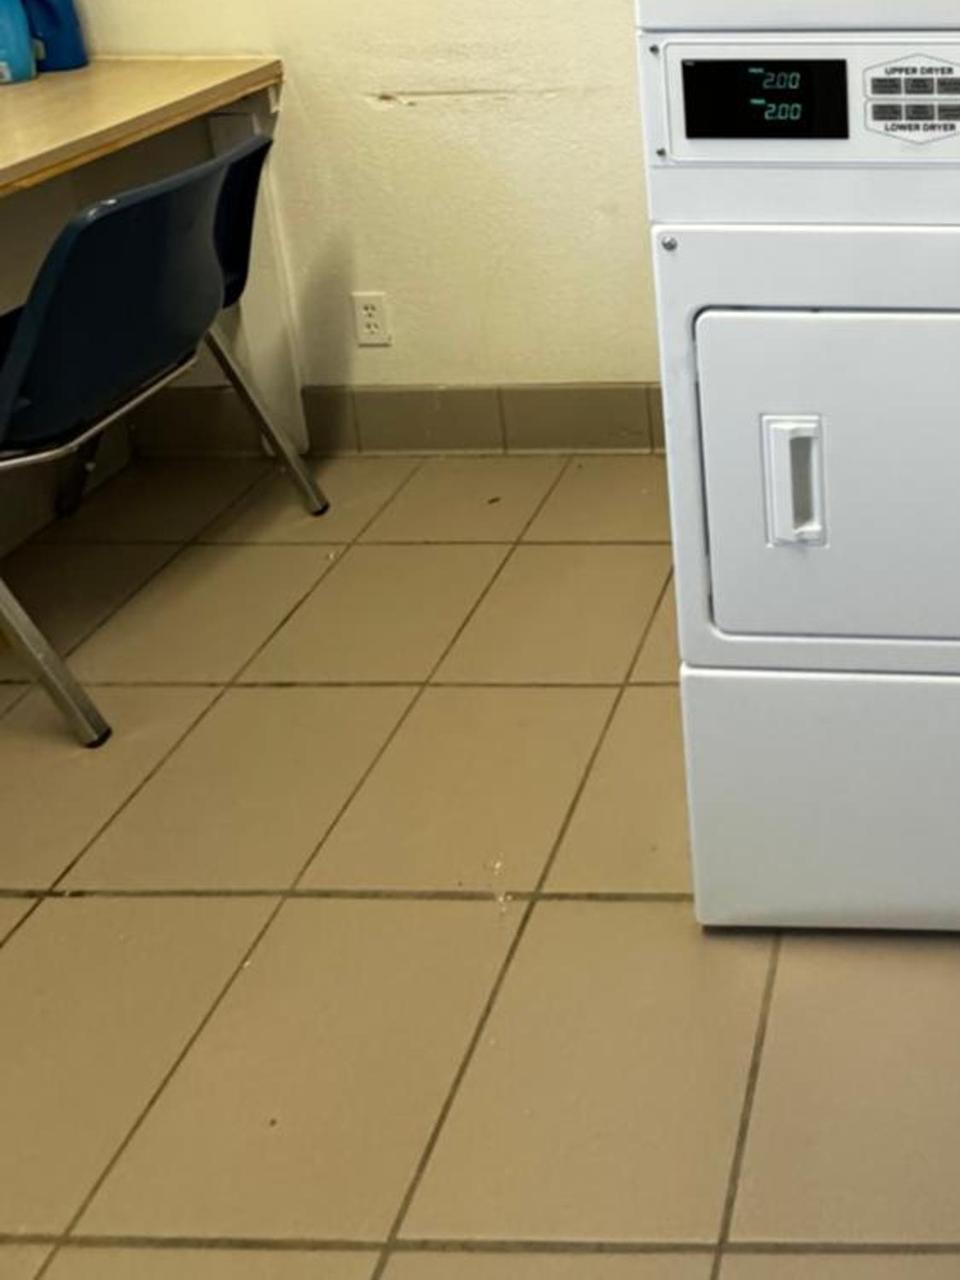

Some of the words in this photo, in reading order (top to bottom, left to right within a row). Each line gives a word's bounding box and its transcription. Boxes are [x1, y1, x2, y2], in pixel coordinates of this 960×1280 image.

[884, 66, 917, 75] UPPER
[920, 66, 954, 75] DRYER
[884, 123, 920, 132] LOWER
[922, 123, 956, 132] DRYER
